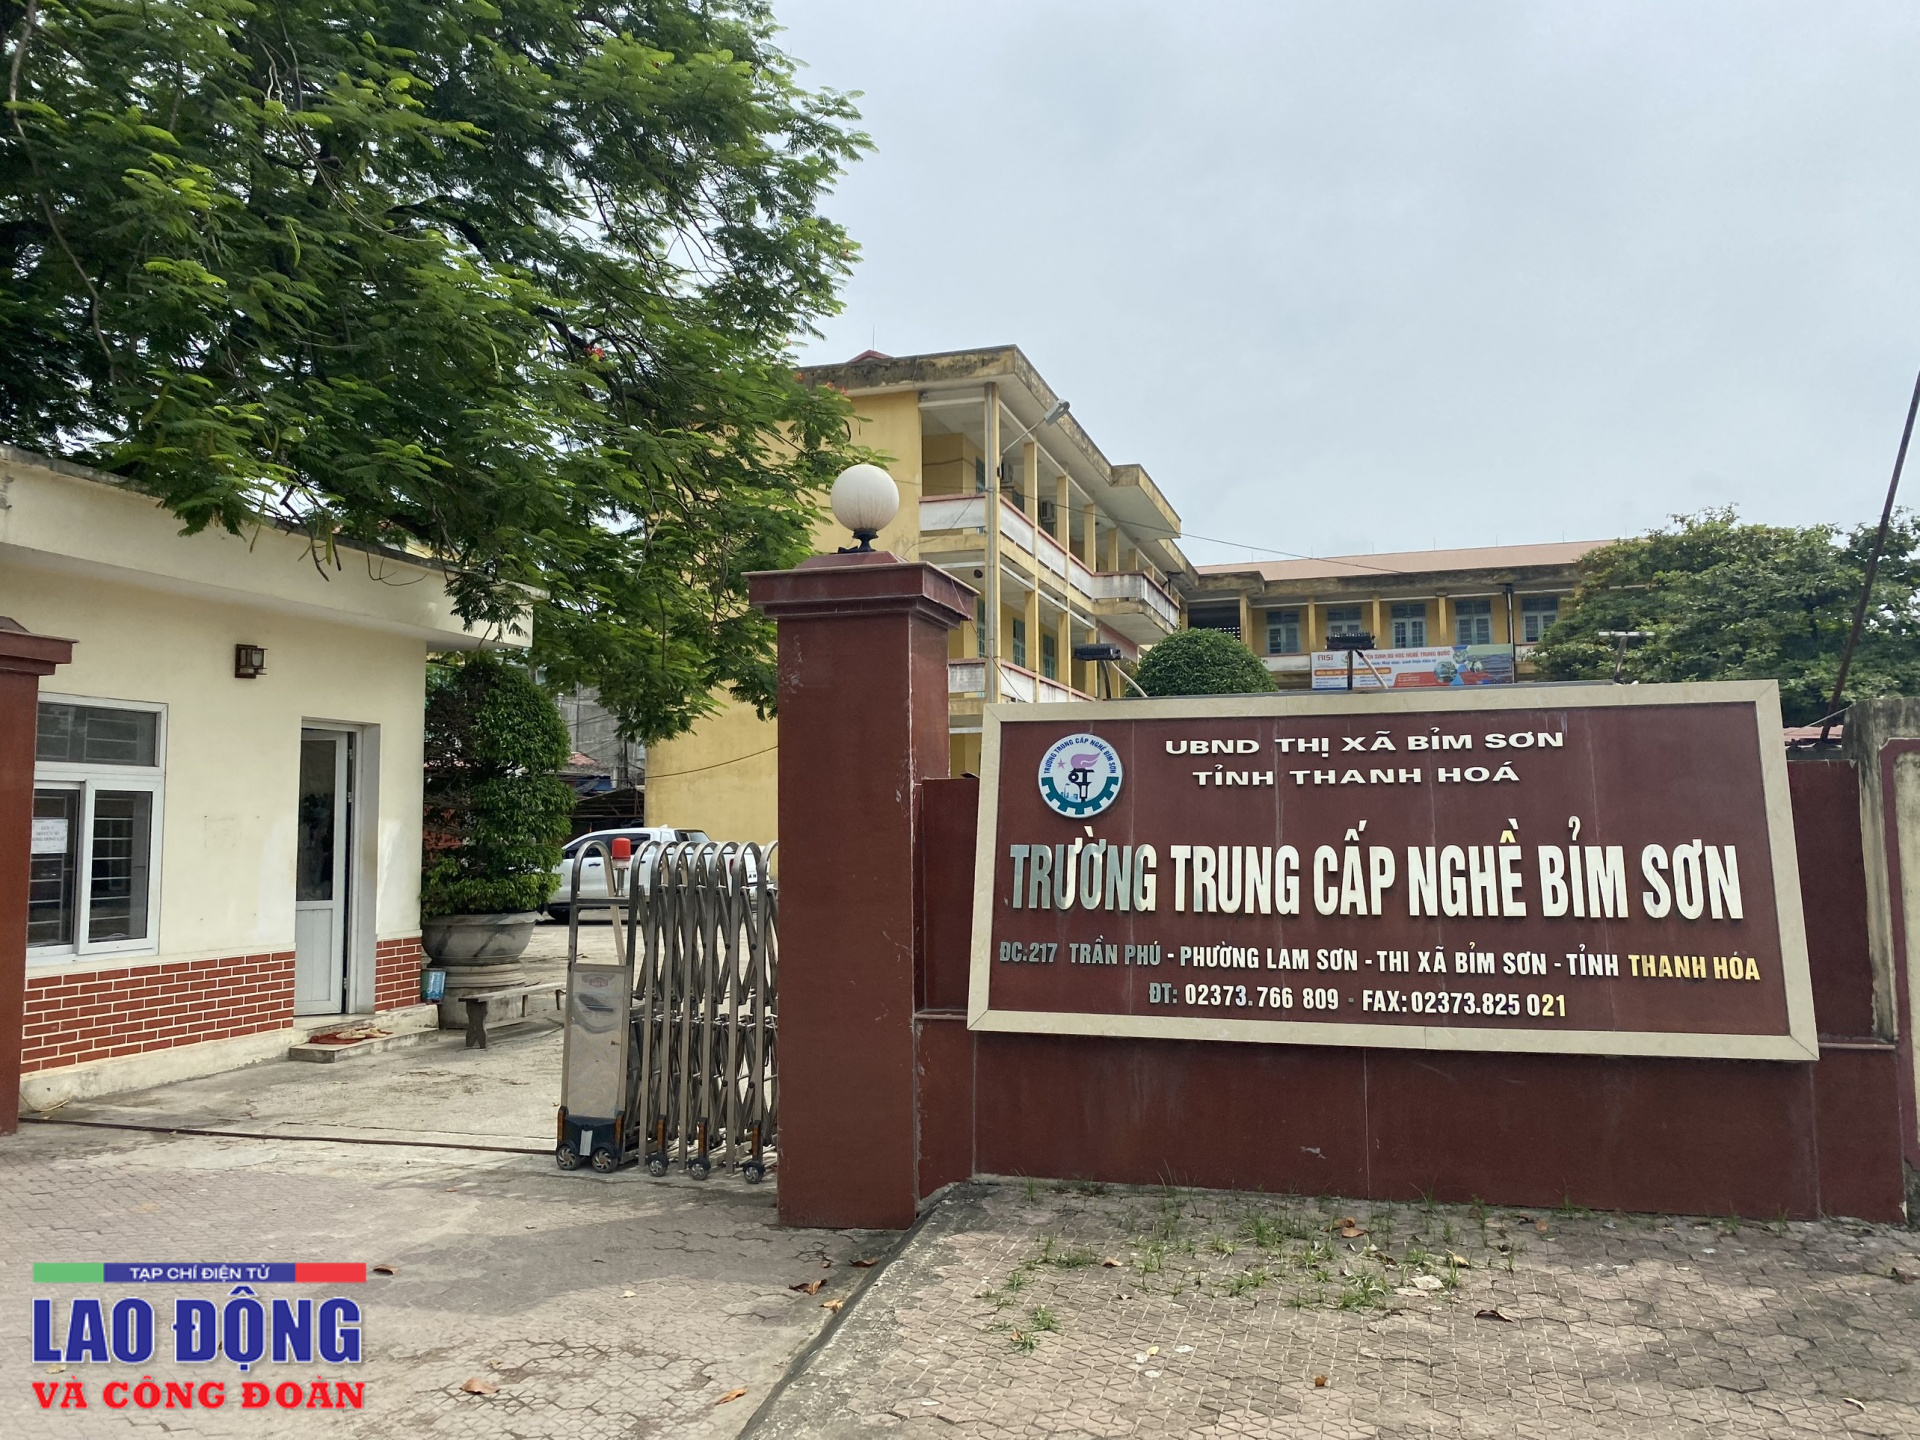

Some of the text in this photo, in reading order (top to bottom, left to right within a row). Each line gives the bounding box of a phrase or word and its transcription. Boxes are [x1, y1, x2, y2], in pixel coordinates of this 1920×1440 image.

[1165, 727, 1563, 757] UBND THỊ XÃ BỈM SƠN
[1193, 761, 1520, 786] TỈNH THANH HOÁ
[1009, 815, 1744, 920] TRƯỜNG TRUNG CẤP NGHỀ BỈM SƠN
[1069, 935, 1117, 965] TRẦN
[1125, 941, 1161, 966] PHÚ
[1180, 941, 1259, 969] PHƯỜNG
[1267, 949, 1309, 970] LAM
[1316, 949, 1358, 971] SƠN
[1417, 945, 1447, 973] XÃ
[1455, 941, 1496, 975] BỈM
[1503, 950, 1547, 975] SƠN
[1566, 943, 1619, 976] TỈNH
[1628, 954, 1707, 979] THANH
[1713, 951, 1761, 981] HÓA
[1149, 982, 1178, 1003] ĐT:
[1302, 988, 1339, 1010] 809
[1526, 993, 1566, 1017] 021
